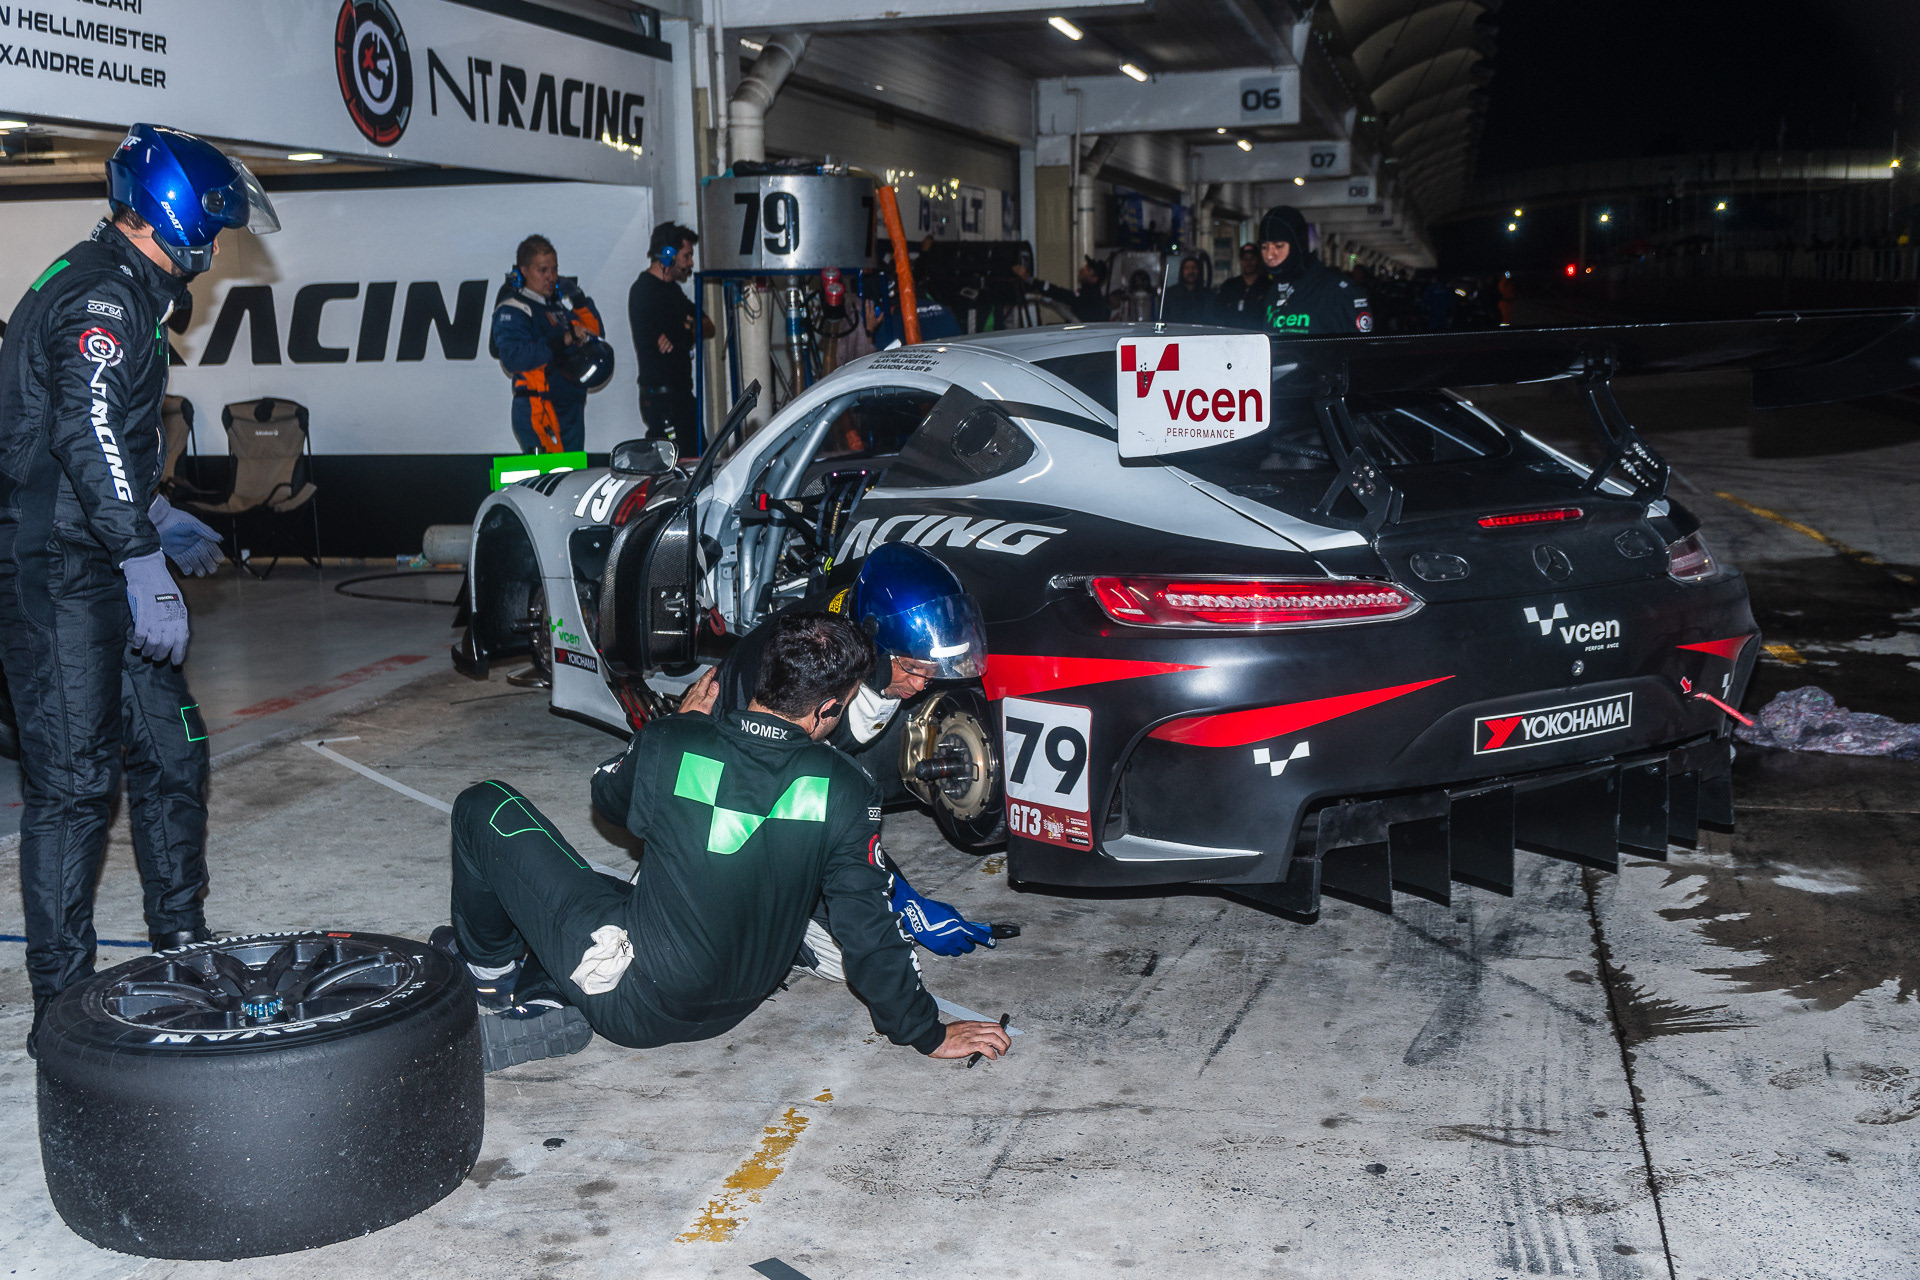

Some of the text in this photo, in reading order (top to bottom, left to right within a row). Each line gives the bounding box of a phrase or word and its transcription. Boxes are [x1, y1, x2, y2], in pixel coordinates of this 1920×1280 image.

[18, 8, 167, 55] HELLMEISTER
[97, 61, 166, 89] AULER
[1241, 88, 1281, 111] 06
[1310, 153, 1336, 168] 07
[734, 191, 800, 255] 79
[1162, 388, 1263, 423] vcen
[1166, 427, 1235, 439] PERFORMANCE
[558, 631, 580, 645] vcen
[1559, 619, 1620, 645] vcen
[567, 652, 597, 671] YOKOHAMA
[741, 719, 788, 740] NOMEX
[1521, 701, 1626, 741] YOKOHAMA
[1005, 715, 1088, 796] 79
[1009, 803, 1042, 836] GT3
